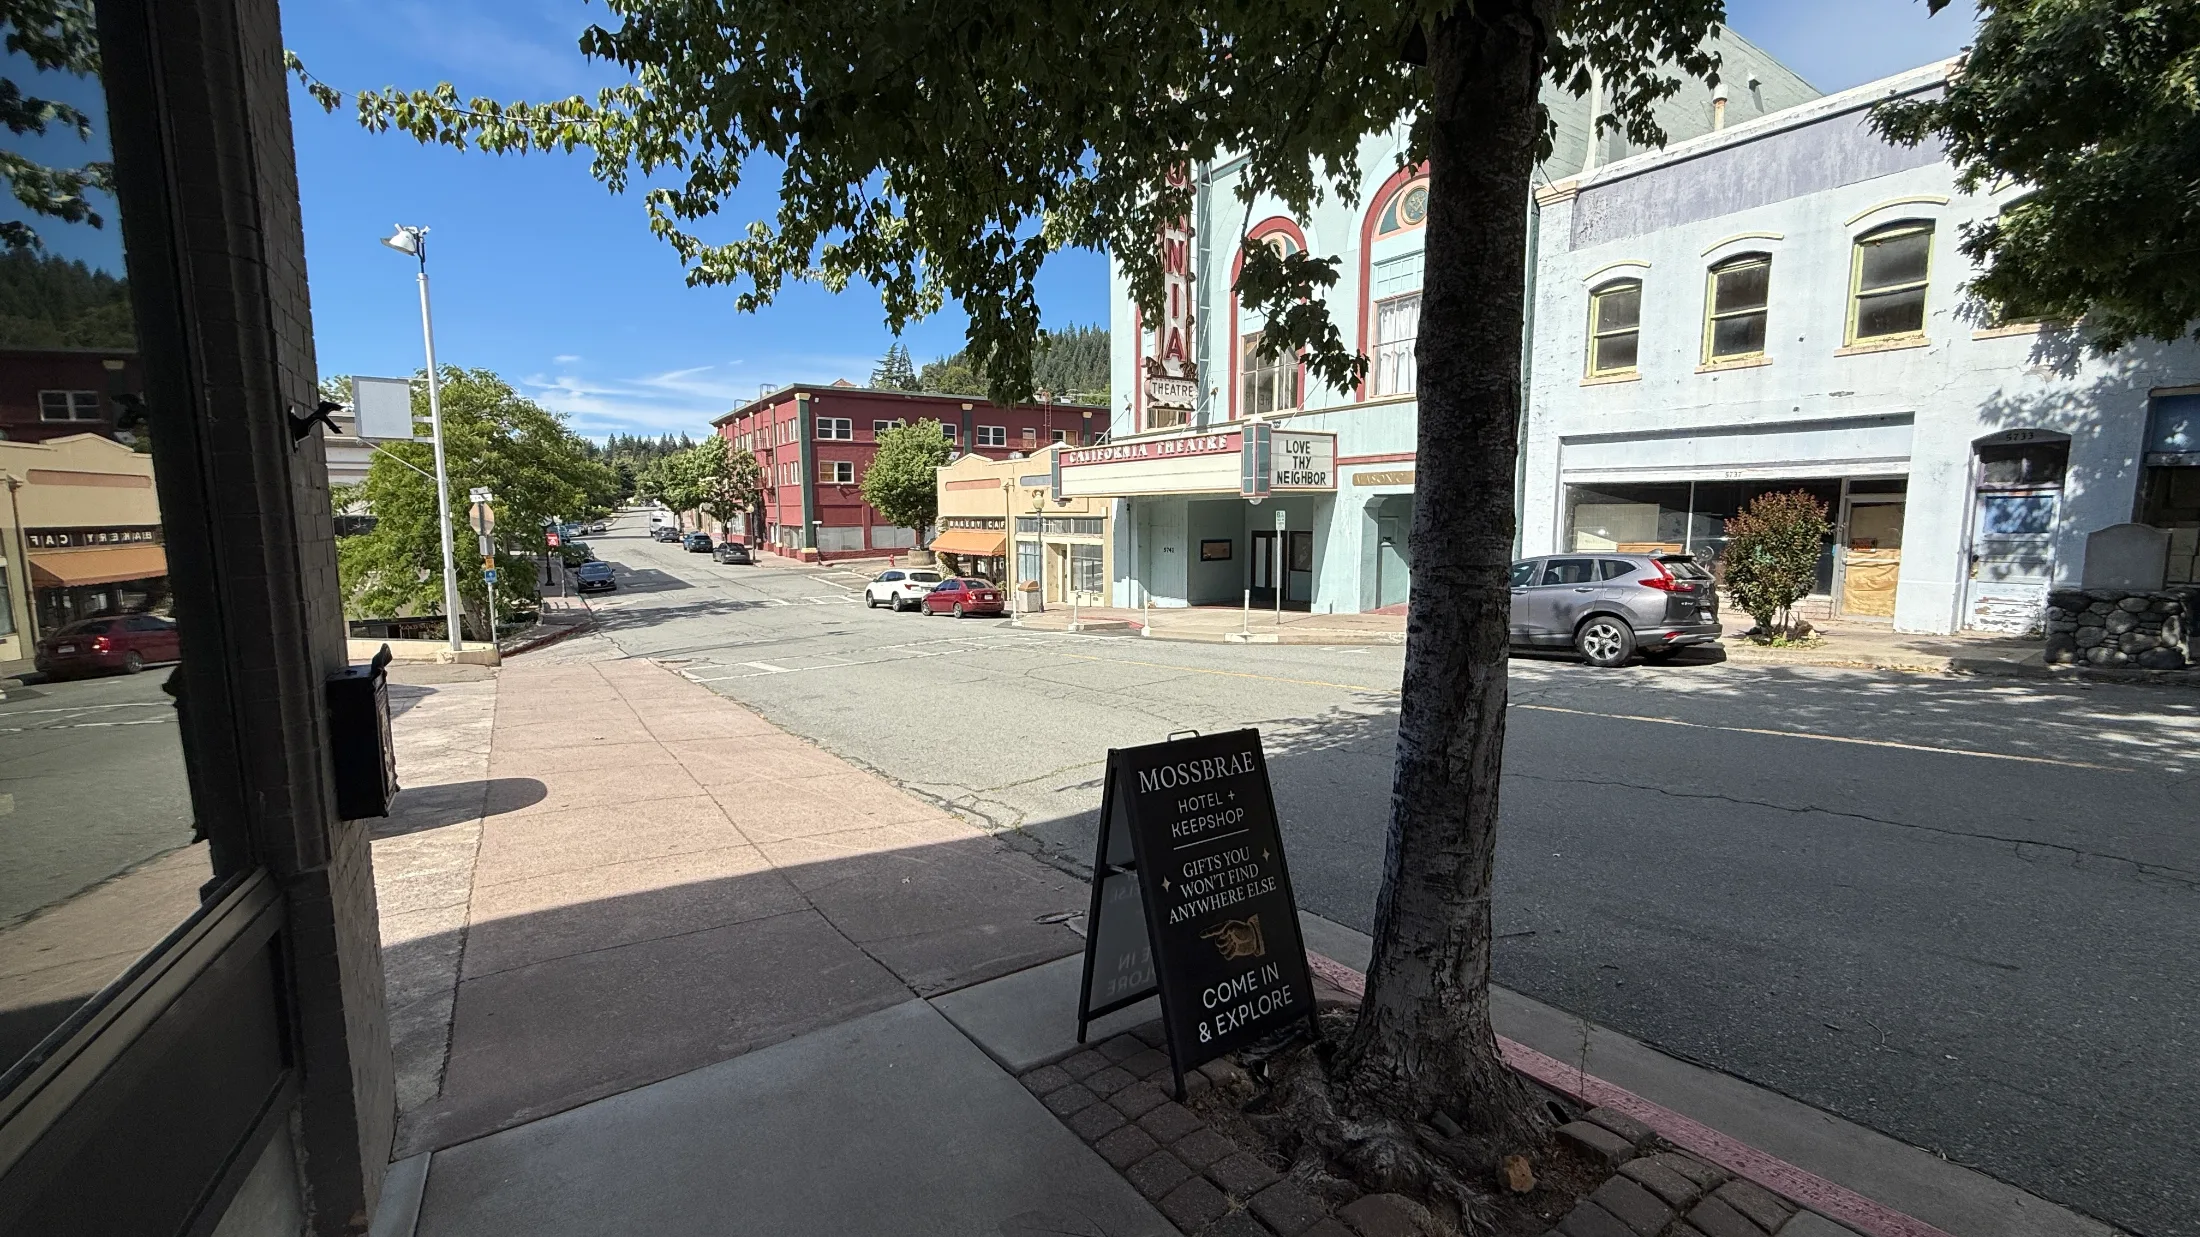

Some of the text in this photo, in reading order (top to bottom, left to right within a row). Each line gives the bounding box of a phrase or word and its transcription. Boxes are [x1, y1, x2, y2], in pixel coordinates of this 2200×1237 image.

[1152, 382, 1194, 397] THEATRE
[1069, 435, 1228, 463] CALIFORNIA THEATRE
[1286, 440, 1311, 454] LOVE
[2006, 432, 2034, 441] 5733
[1292, 456, 1312, 469] THY
[1277, 471, 1326, 485] NEIGHBOR
[1138, 751, 1255, 793] MOSSBRAE
[1178, 792, 1223, 814] HOTEL
[1171, 807, 1244, 838] KEEPSHOP
[1183, 846, 1250, 878] GIFTS YOU
[1180, 863, 1259, 899] WON'T FIND
[1169, 876, 1277, 925] ANYWHERE ELSE
[1203, 961, 1279, 1009] COME IN
[1198, 984, 1293, 1043] & EXPLORE
